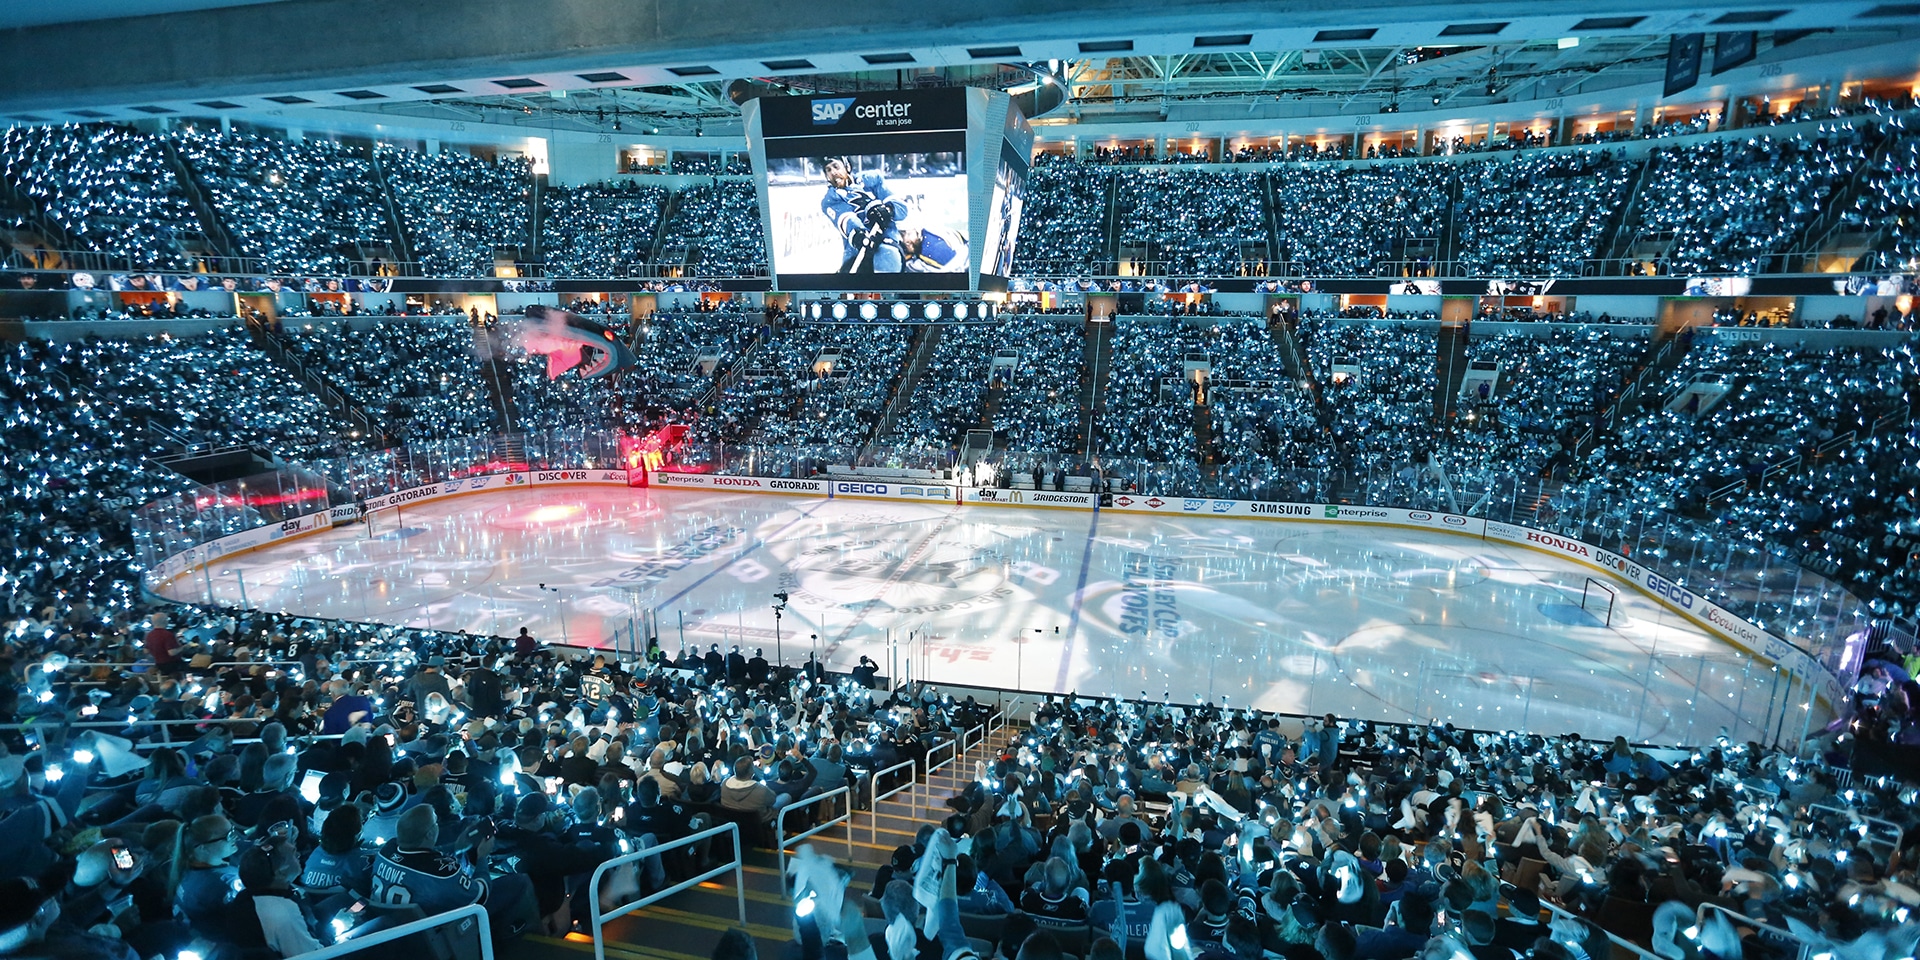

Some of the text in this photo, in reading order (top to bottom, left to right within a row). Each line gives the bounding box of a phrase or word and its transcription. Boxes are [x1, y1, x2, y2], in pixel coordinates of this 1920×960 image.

[1759, 64, 1782, 78] 205
[812, 100, 912, 120] SAP center
[1544, 99, 1564, 110] 204
[898, 118, 912, 126] jose
[1355, 116, 1370, 126] 203
[450, 122, 466, 132] 225
[1186, 122, 1200, 132] 202
[598, 134, 612, 143] 226
[538, 472, 586, 481] DISCOVER
[658, 473, 704, 484] enterprise
[714, 478, 762, 486] HONDA
[770, 480, 820, 490] GATORADE
[838, 483, 888, 494] GEICO
[389, 486, 438, 504] GATORADE
[979, 488, 998, 499] day
[1033, 493, 1089, 504] BRIDGESTONE
[1251, 503, 1311, 516] SAMSUNG
[1326, 506, 1388, 518] enterprise
[282, 520, 302, 532] day
[1526, 532, 1590, 557] HONDA
[1596, 550, 1640, 580] DISCOVER
[1646, 574, 1694, 610] GEICO
[1708, 607, 1758, 644] Coors LIGHT
[288, 644, 298, 658] 8
[306, 871, 341, 886] BURNS
[376, 862, 406, 885] CLOWE
